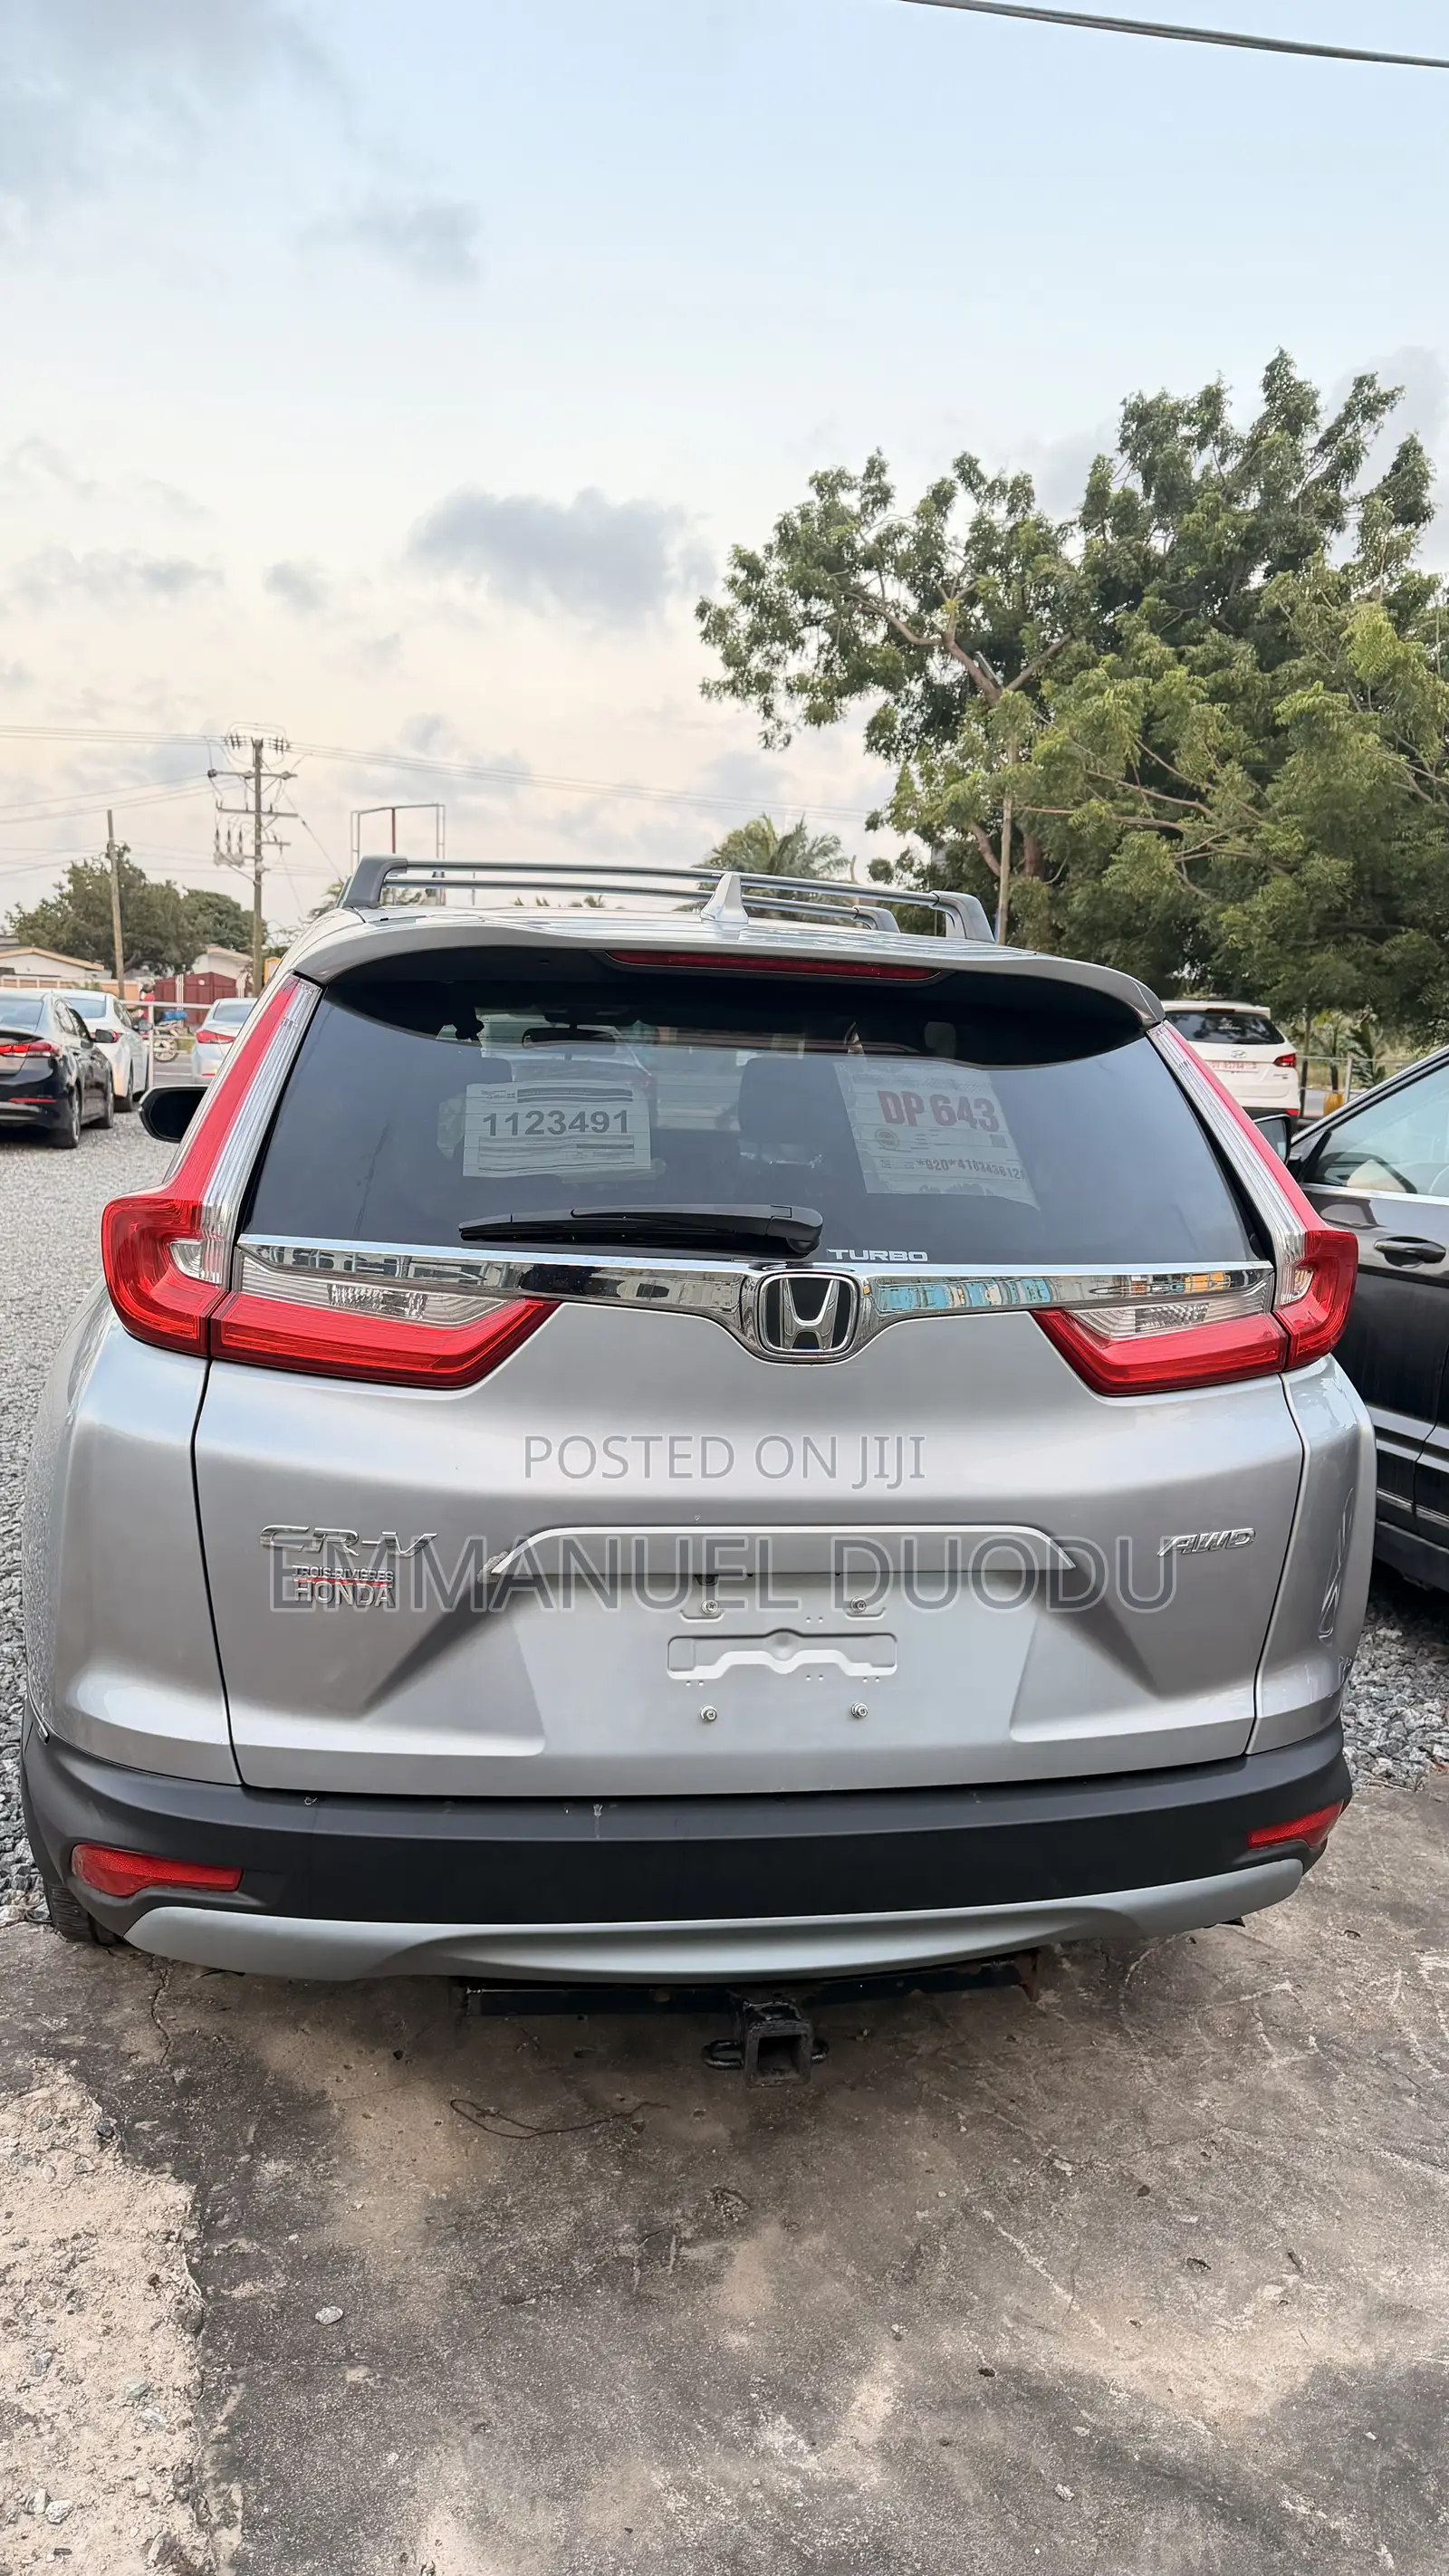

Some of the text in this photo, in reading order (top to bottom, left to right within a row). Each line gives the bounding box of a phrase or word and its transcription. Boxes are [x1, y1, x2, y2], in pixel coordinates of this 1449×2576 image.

[483, 1109, 629, 1136] 1123491
[877, 1089, 1001, 1133] DP 643
[826, 1249, 928, 1262] TURBO
[260, 1525, 438, 1559] CR-V
[1157, 1527, 1256, 1556] AWD
[293, 1580, 397, 1608] HONDA
